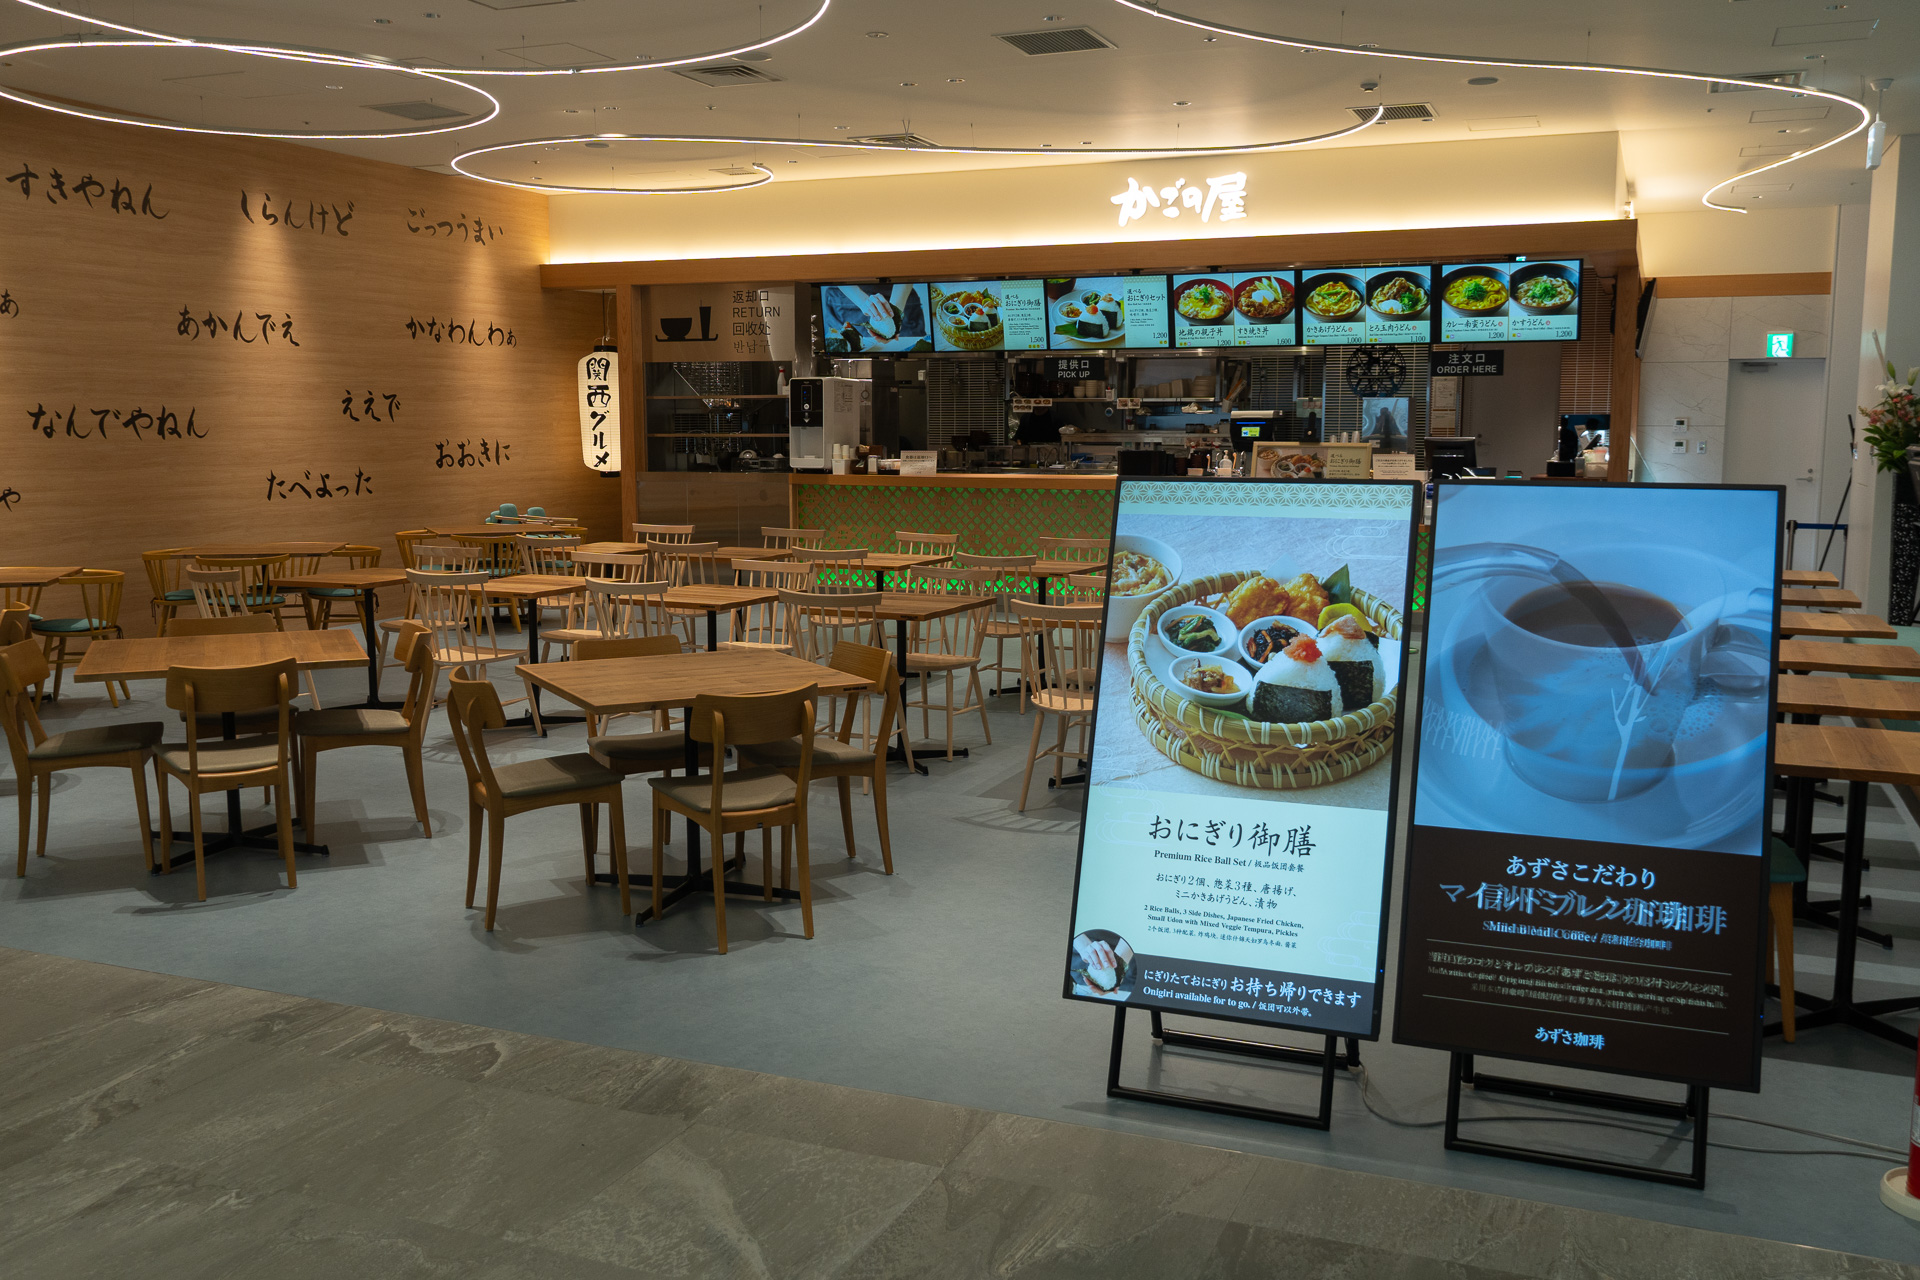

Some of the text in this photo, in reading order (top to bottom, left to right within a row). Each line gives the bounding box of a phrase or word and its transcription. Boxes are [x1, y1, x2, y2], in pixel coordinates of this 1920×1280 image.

[5, 162, 169, 220] すきやねん
[1110, 171, 1247, 227] かごの屋
[240, 189, 355, 237] しらんけど
[407, 207, 504, 246] ごっつうまい
[732, 290, 769, 304] 返却口
[1127, 293, 1166, 302] おにぎりセット
[732, 306, 780, 318] RETURN
[1445, 319, 1497, 328] カレー南蛮うどん
[176, 303, 300, 347] あかんでえ
[404, 315, 517, 348] かなわんわぁ
[732, 321, 771, 336] 回收处
[1306, 325, 1348, 334] かきあげうどん
[1369, 323, 1411, 332] とろ玉肉うどん
[1555, 330, 1573, 338] 1,200
[733, 339, 771, 354] 반납구
[1058, 359, 1090, 370] 提供口
[1436, 364, 1497, 374] ORDER HERE
[1448, 353, 1486, 364] 注文口
[1057, 370, 1090, 378] PICK UP
[341, 389, 401, 423] ええで
[586, 357, 611, 467] 関西グルメ
[26, 402, 209, 441] なんでやねん
[434, 438, 511, 469] おおきに
[266, 466, 374, 502] たべよった
[1148, 815, 1316, 858] おにぎり御膳
[1154, 850, 1192, 861] Premium
[1194, 853, 1213, 863] Rice
[1214, 855, 1231, 865] Ball
[1232, 858, 1247, 867] Set
[1506, 855, 1656, 890] あずさこだわり
[1147, 914, 1165, 922] Small
[1167, 916, 1183, 924] Udon
[1199, 920, 1219, 928] Mixed
[1221, 922, 1242, 931] Veggie
[1243, 925, 1274, 935] Tempura,
[1275, 928, 1299, 937] Pickles
[1164, 907, 1182, 915] Balls,
[1188, 909, 1201, 917] Side
[1203, 911, 1225, 920] Dishes,
[1227, 914, 1255, 923] Japanese
[1256, 917, 1274, 925] Fried
[1275, 919, 1304, 929] Chicken,
[1142, 986, 1174, 999] Onigiri
[1174, 990, 1212, 1003] available
[1213, 995, 1226, 1005] for
[1227, 998, 1237, 1007] to
[1237, 1000, 1251, 1009] go.
[1534, 1026, 1606, 1050] あずさ珈琲
